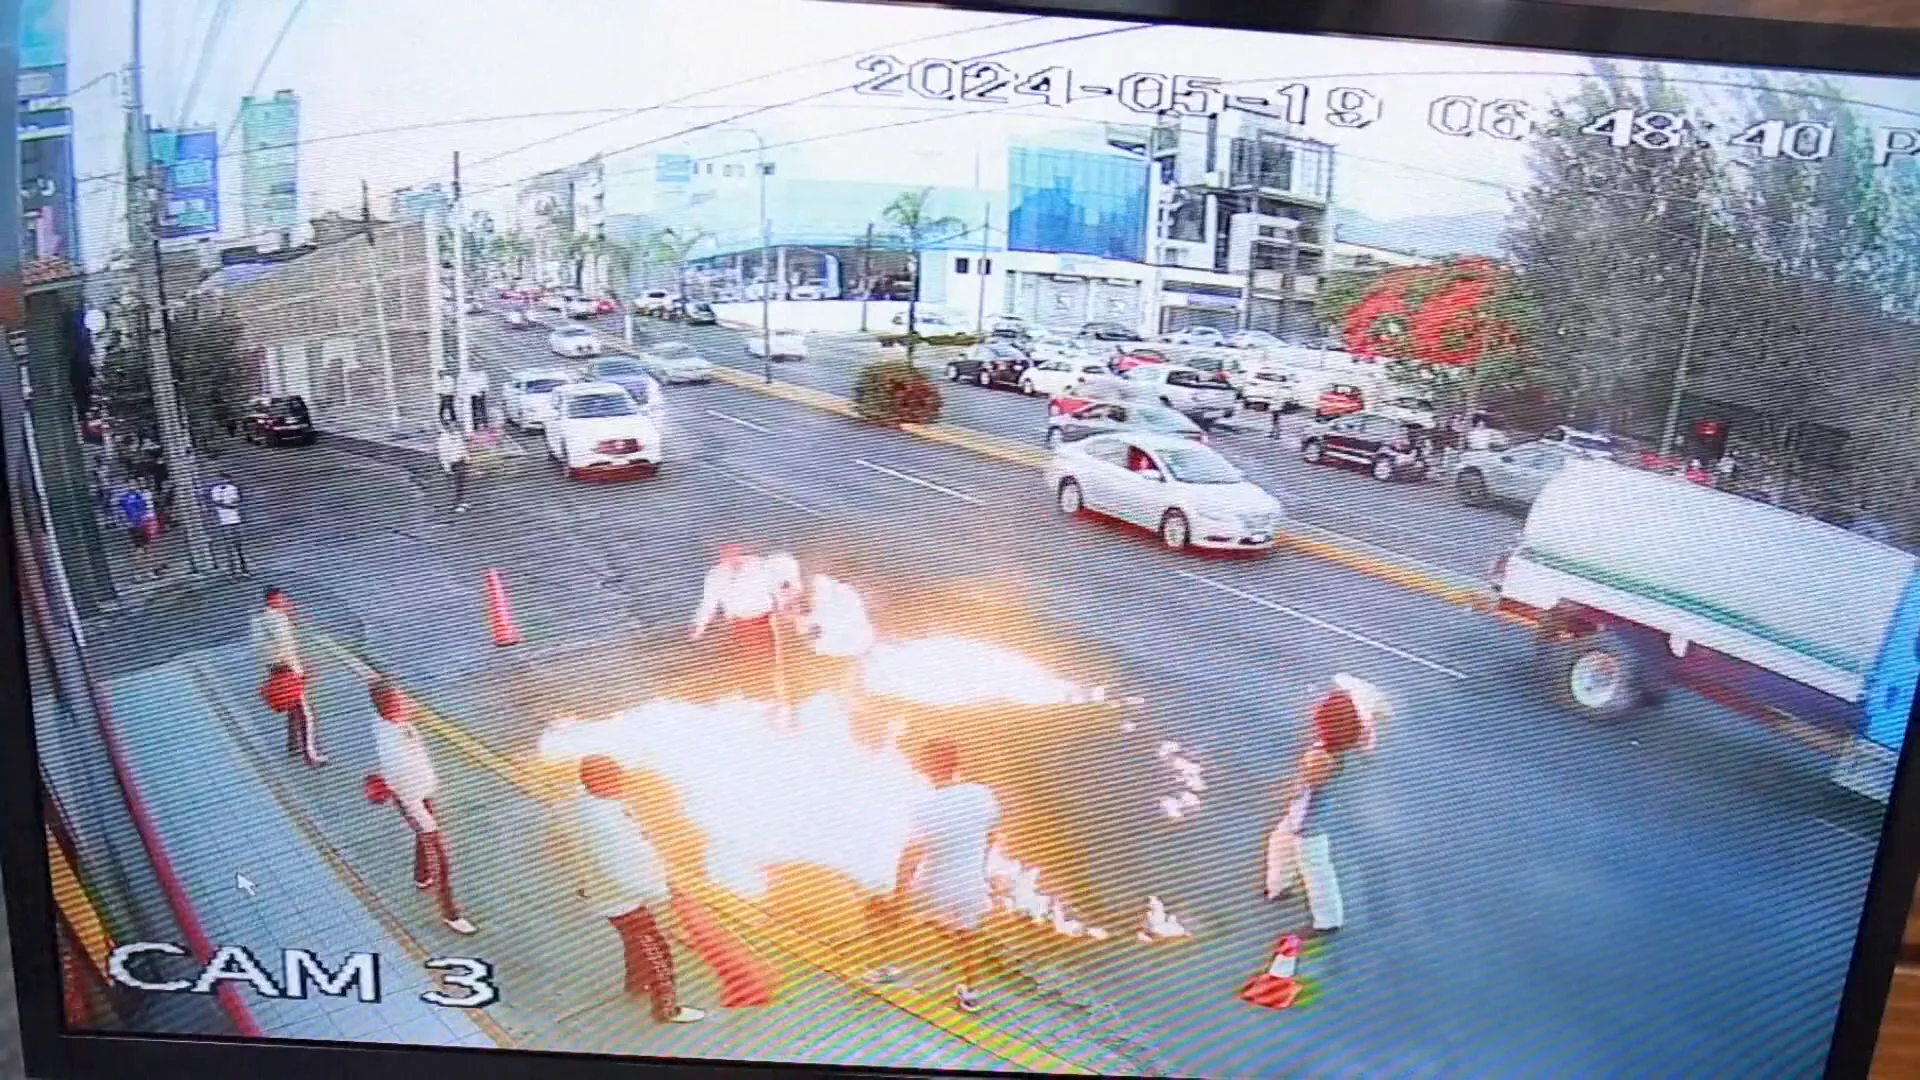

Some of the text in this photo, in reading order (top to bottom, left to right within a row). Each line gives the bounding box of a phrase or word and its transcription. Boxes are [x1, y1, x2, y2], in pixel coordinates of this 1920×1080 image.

[855, 55, 1384, 128] 2024-05-19
[108, 941, 501, 1008] CAM 3
